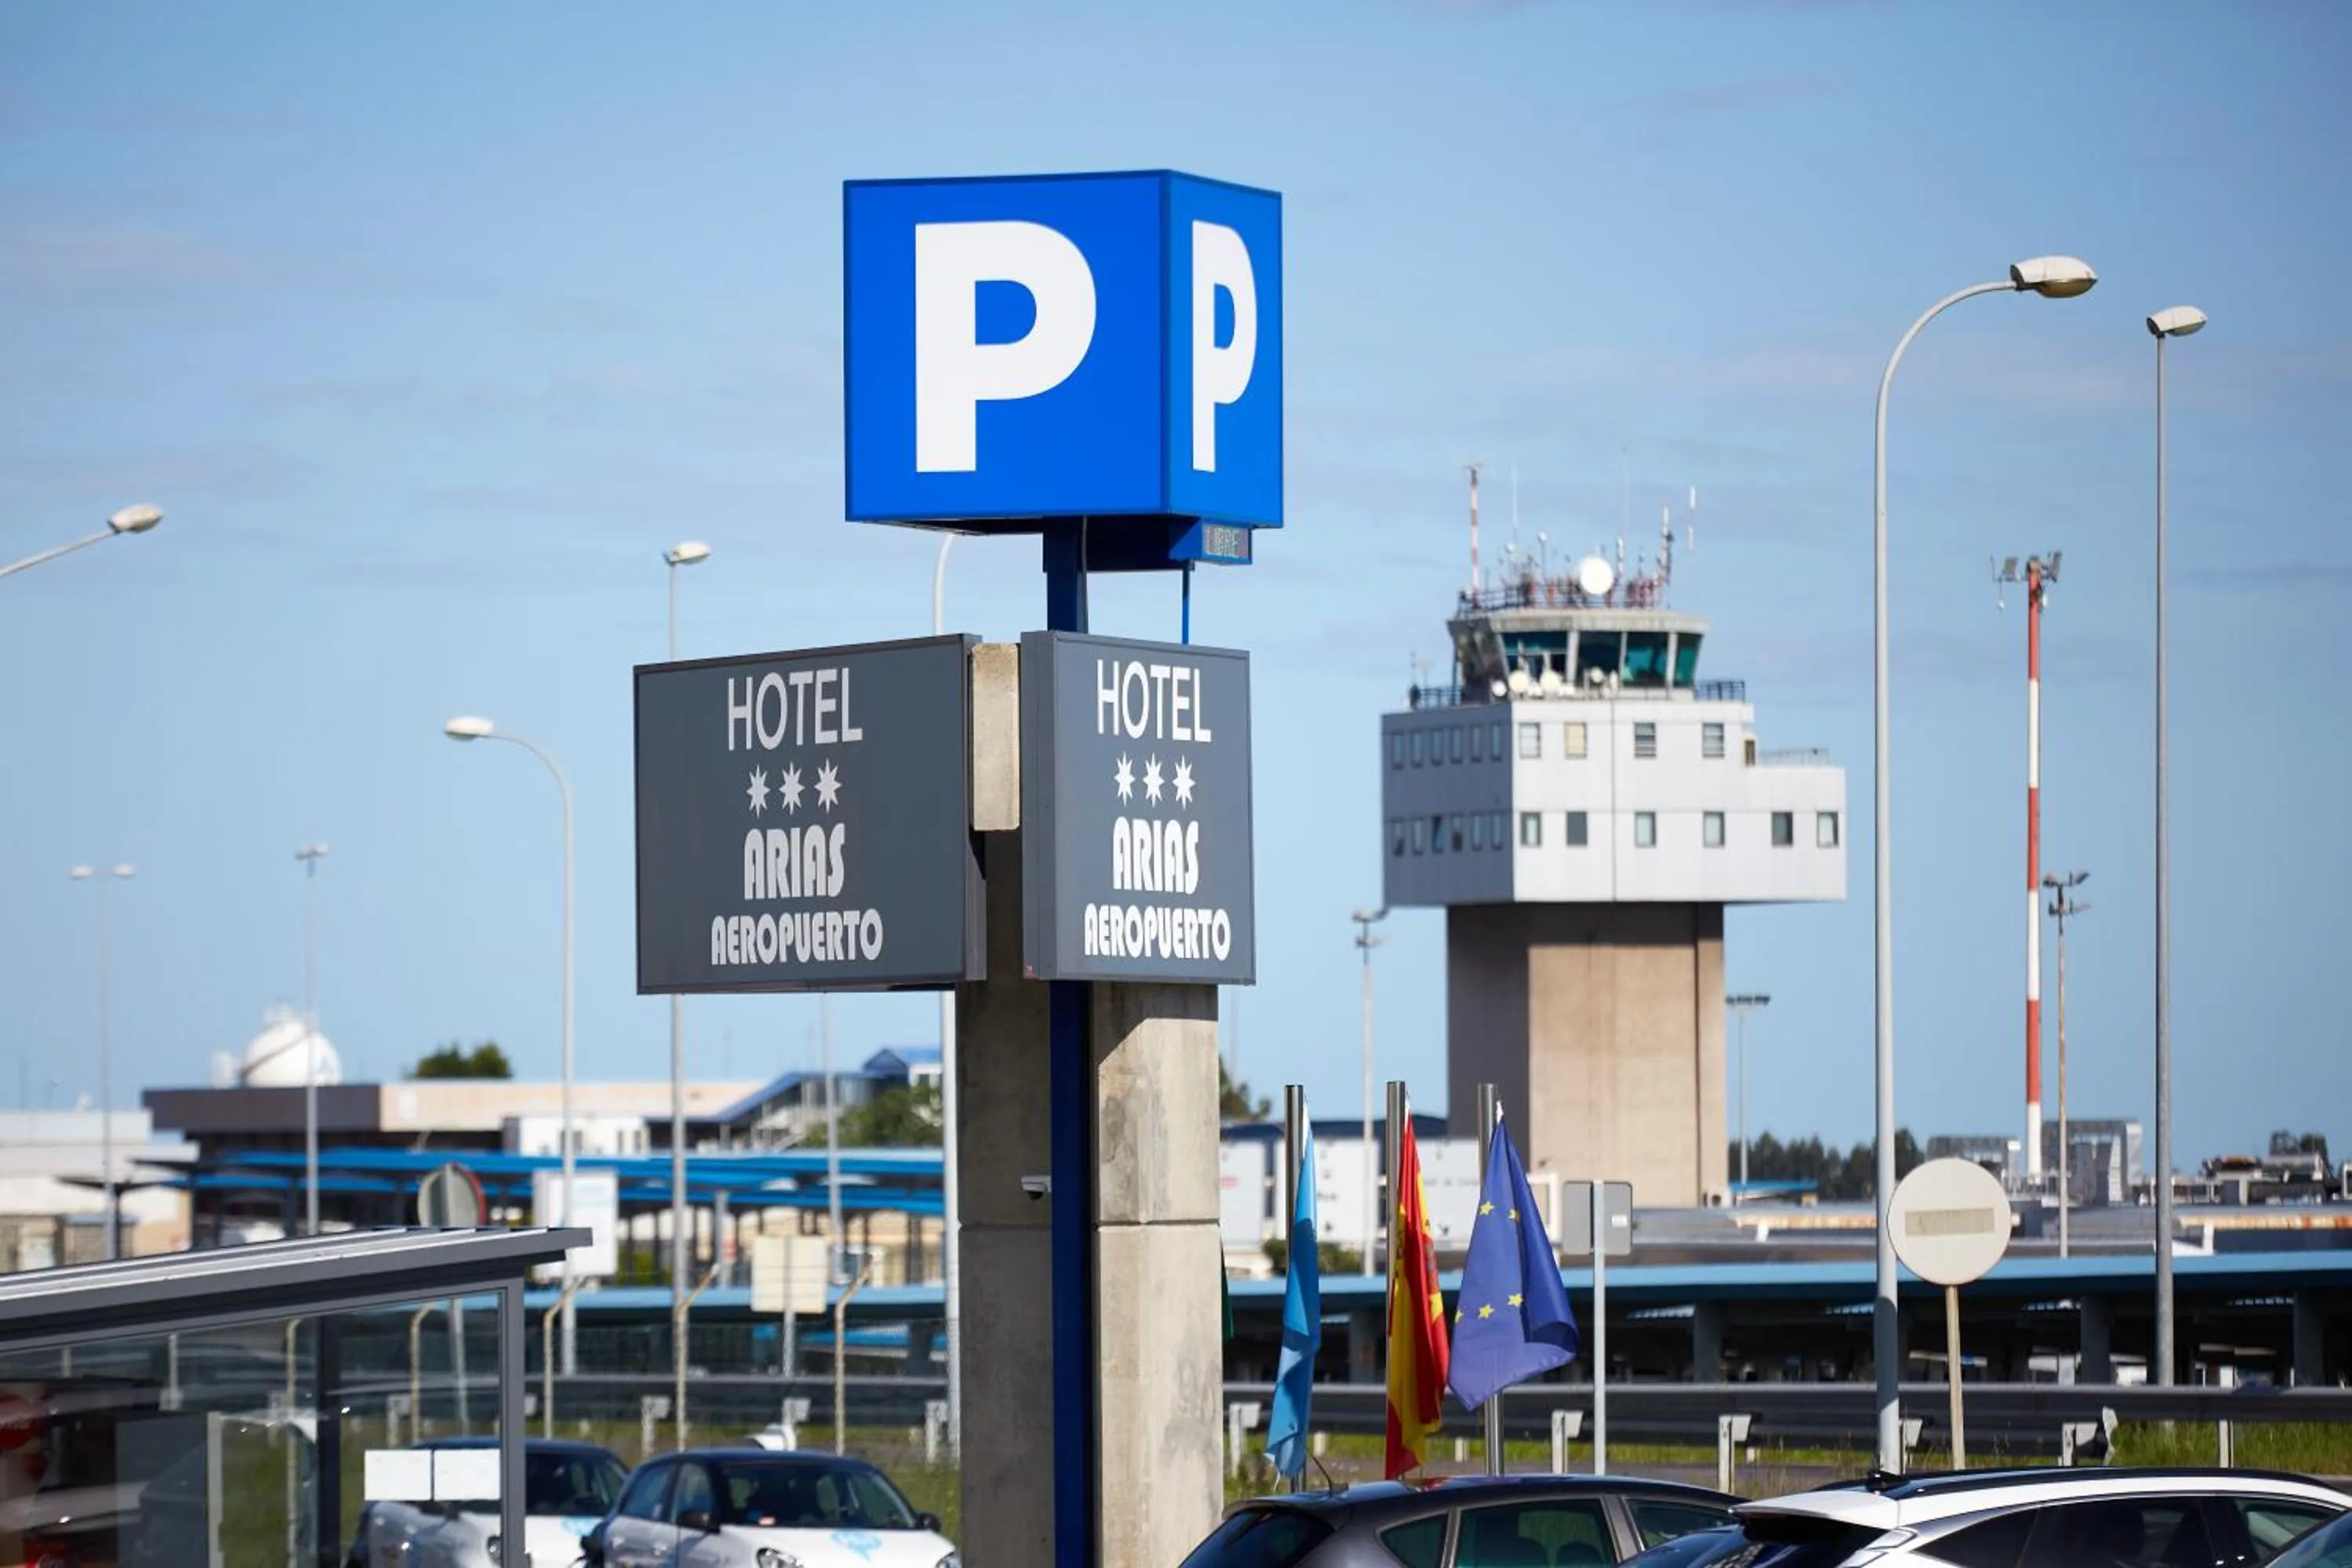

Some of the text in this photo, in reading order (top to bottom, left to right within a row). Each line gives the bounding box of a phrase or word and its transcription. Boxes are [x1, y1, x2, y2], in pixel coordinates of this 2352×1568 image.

[916, 221, 1095, 472] P
[1192, 220, 1257, 472] P
[728, 667, 863, 750] HOTEL
[1097, 659, 1212, 743] HOTEL
[744, 822, 845, 900] ARIAS
[1112, 816, 1199, 895] ARIAS
[711, 909, 884, 965] AEROPUERTO
[1084, 903, 1231, 960] AEROPUERTO
